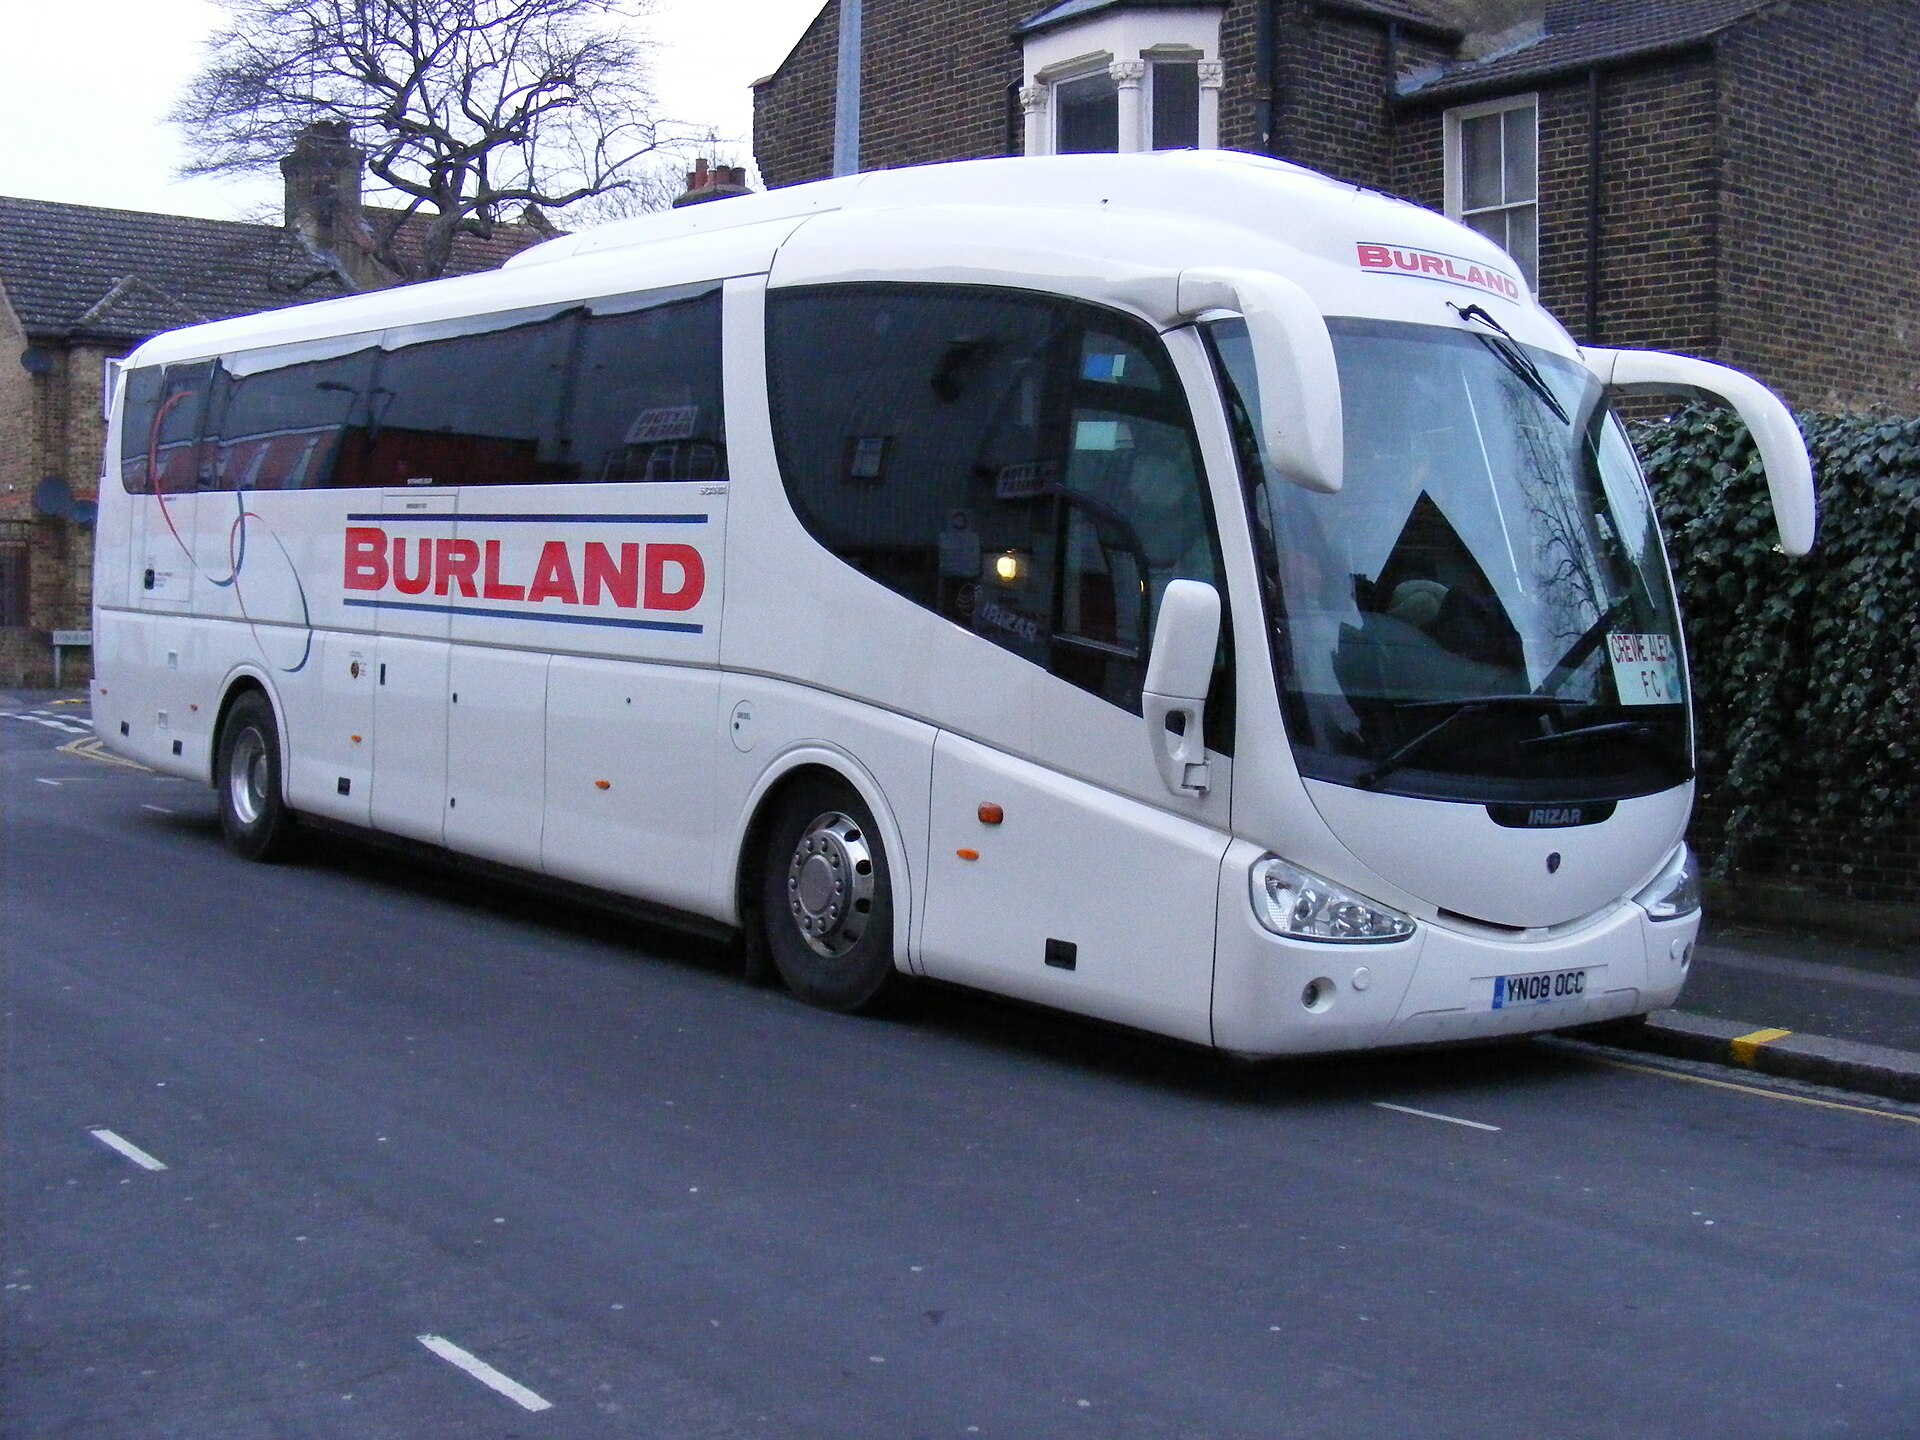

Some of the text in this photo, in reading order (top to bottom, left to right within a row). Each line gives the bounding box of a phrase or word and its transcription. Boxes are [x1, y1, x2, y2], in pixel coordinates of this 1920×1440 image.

[1357, 245, 1519, 300] BURLAND
[344, 527, 705, 612] BURLAND
[1611, 634, 1648, 663] CREWE
[1527, 808, 1582, 826] IRIZAR
[1507, 971, 1585, 1002] YN08 OCC
